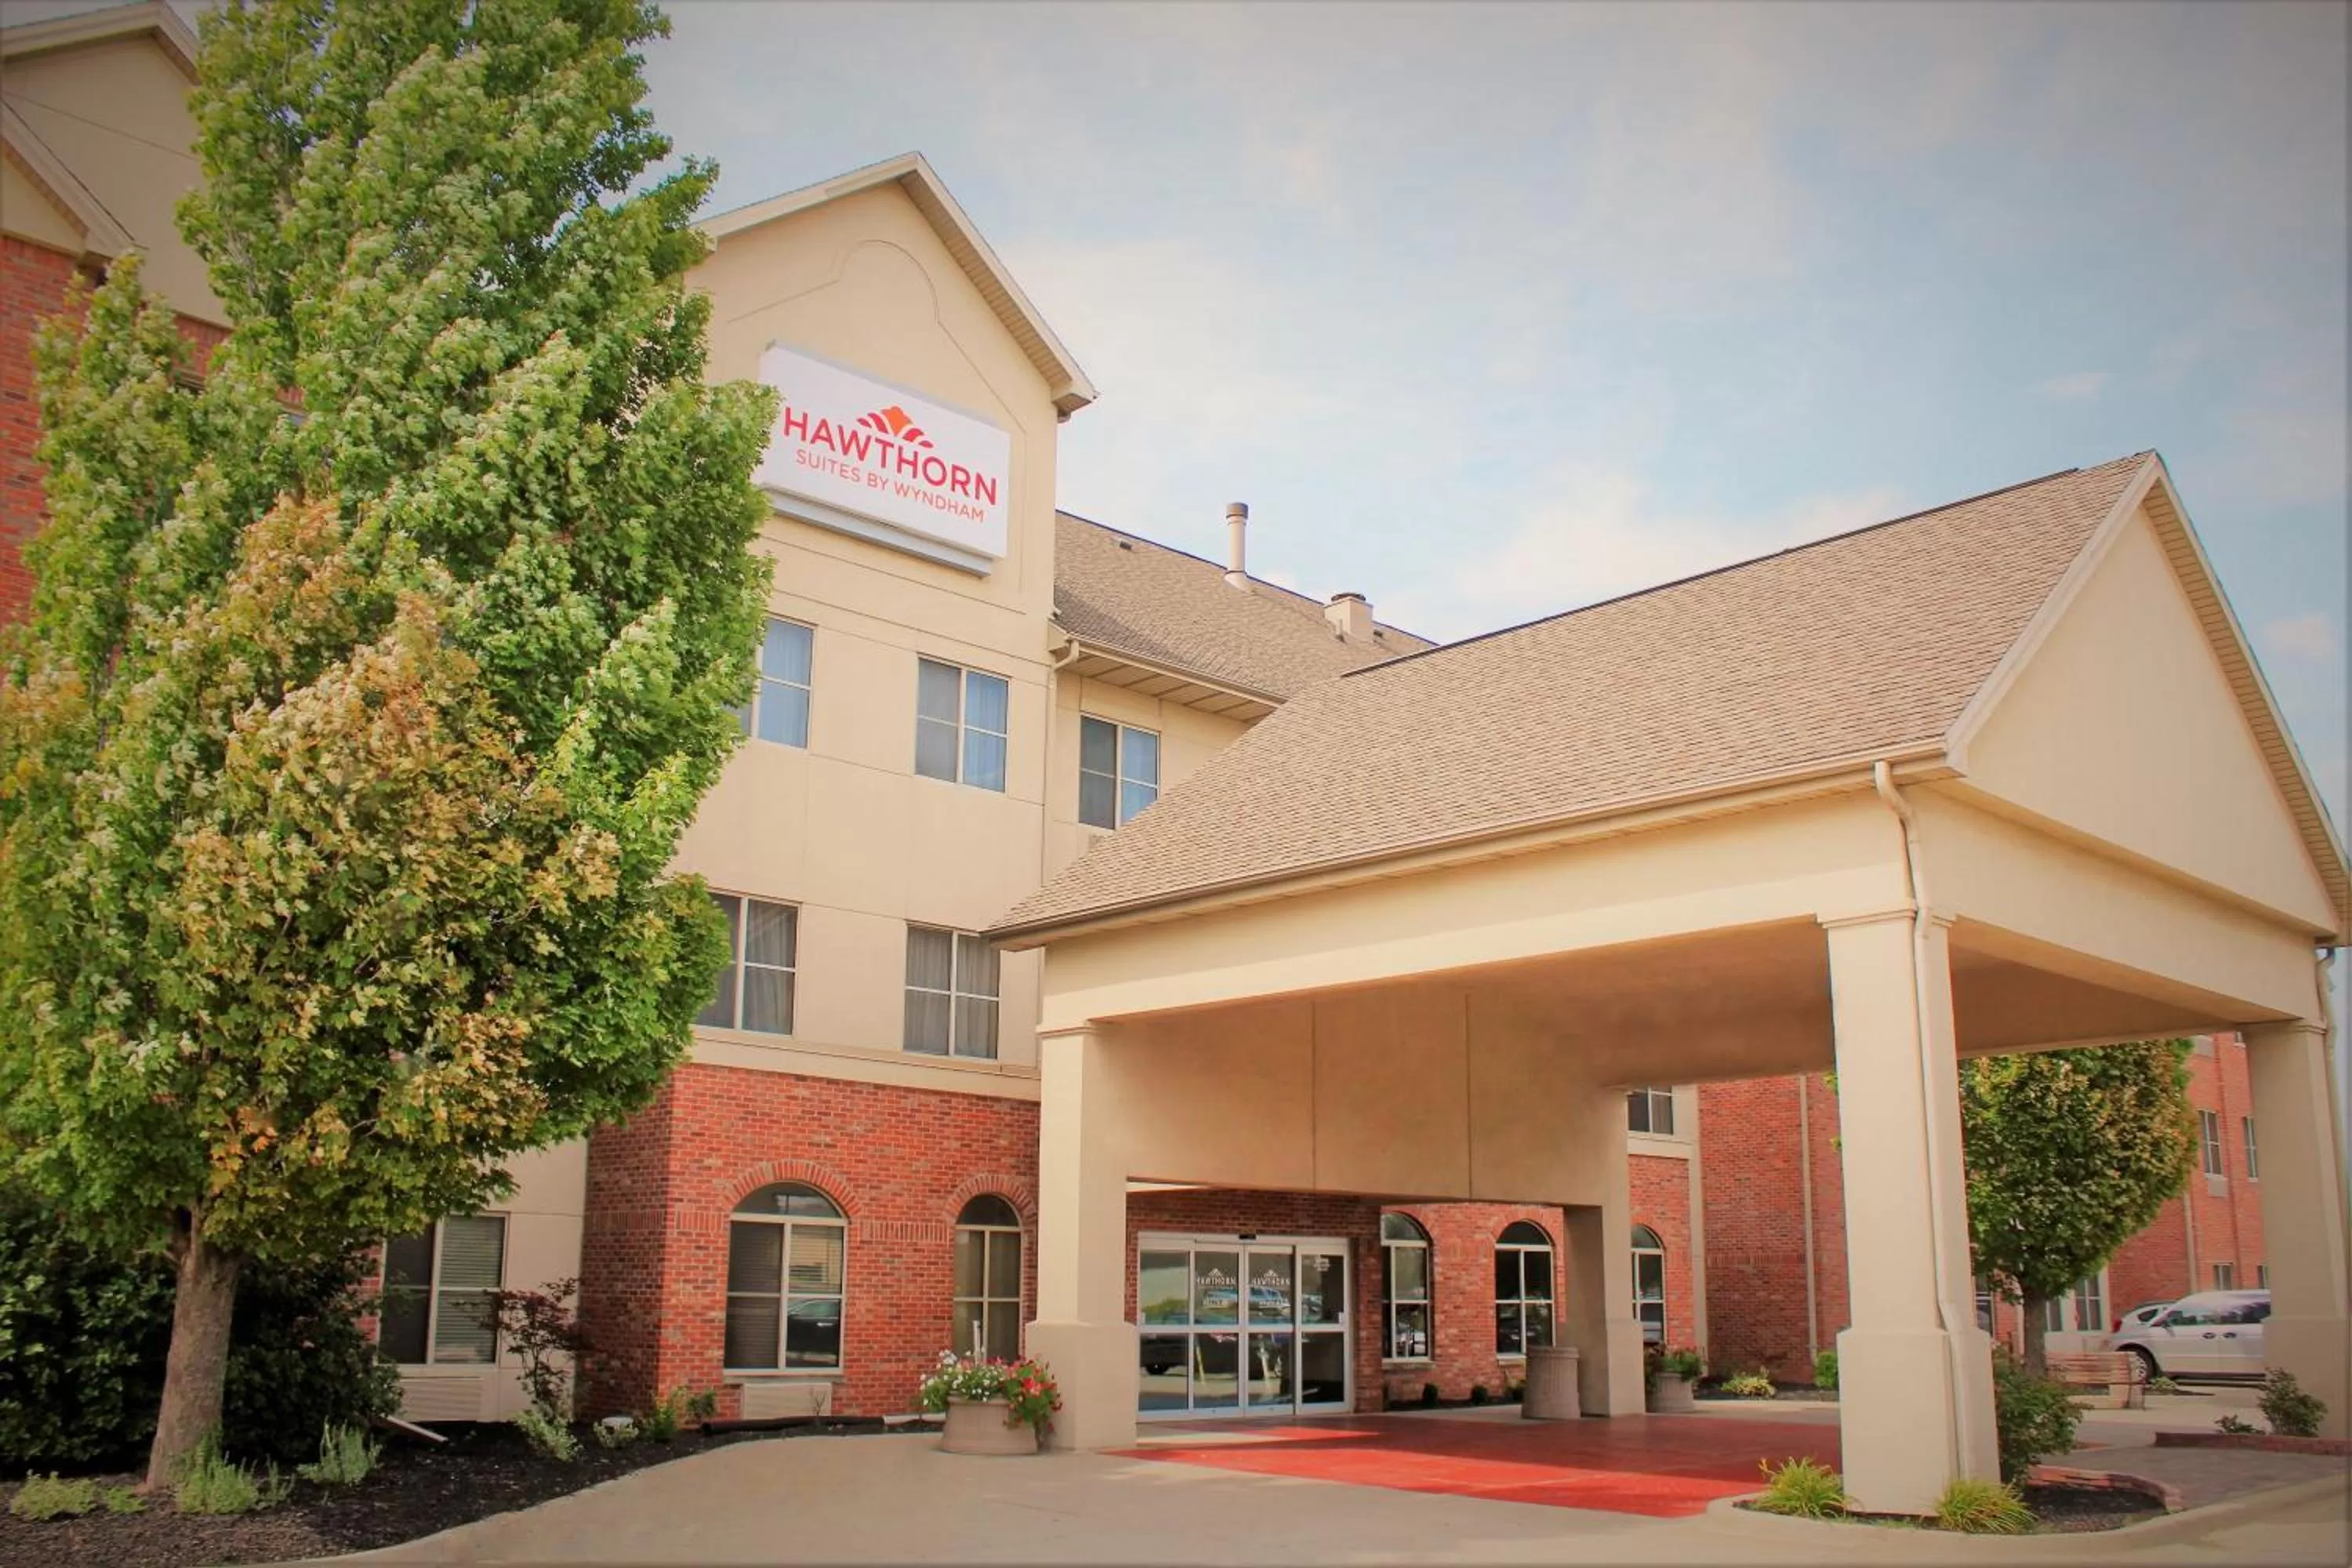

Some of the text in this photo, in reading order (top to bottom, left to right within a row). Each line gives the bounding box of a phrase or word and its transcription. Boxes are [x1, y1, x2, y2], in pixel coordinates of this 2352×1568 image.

[783, 407, 996, 506] HAWTHORN
[796, 449, 985, 523] SUITES BY WYNDHAM
